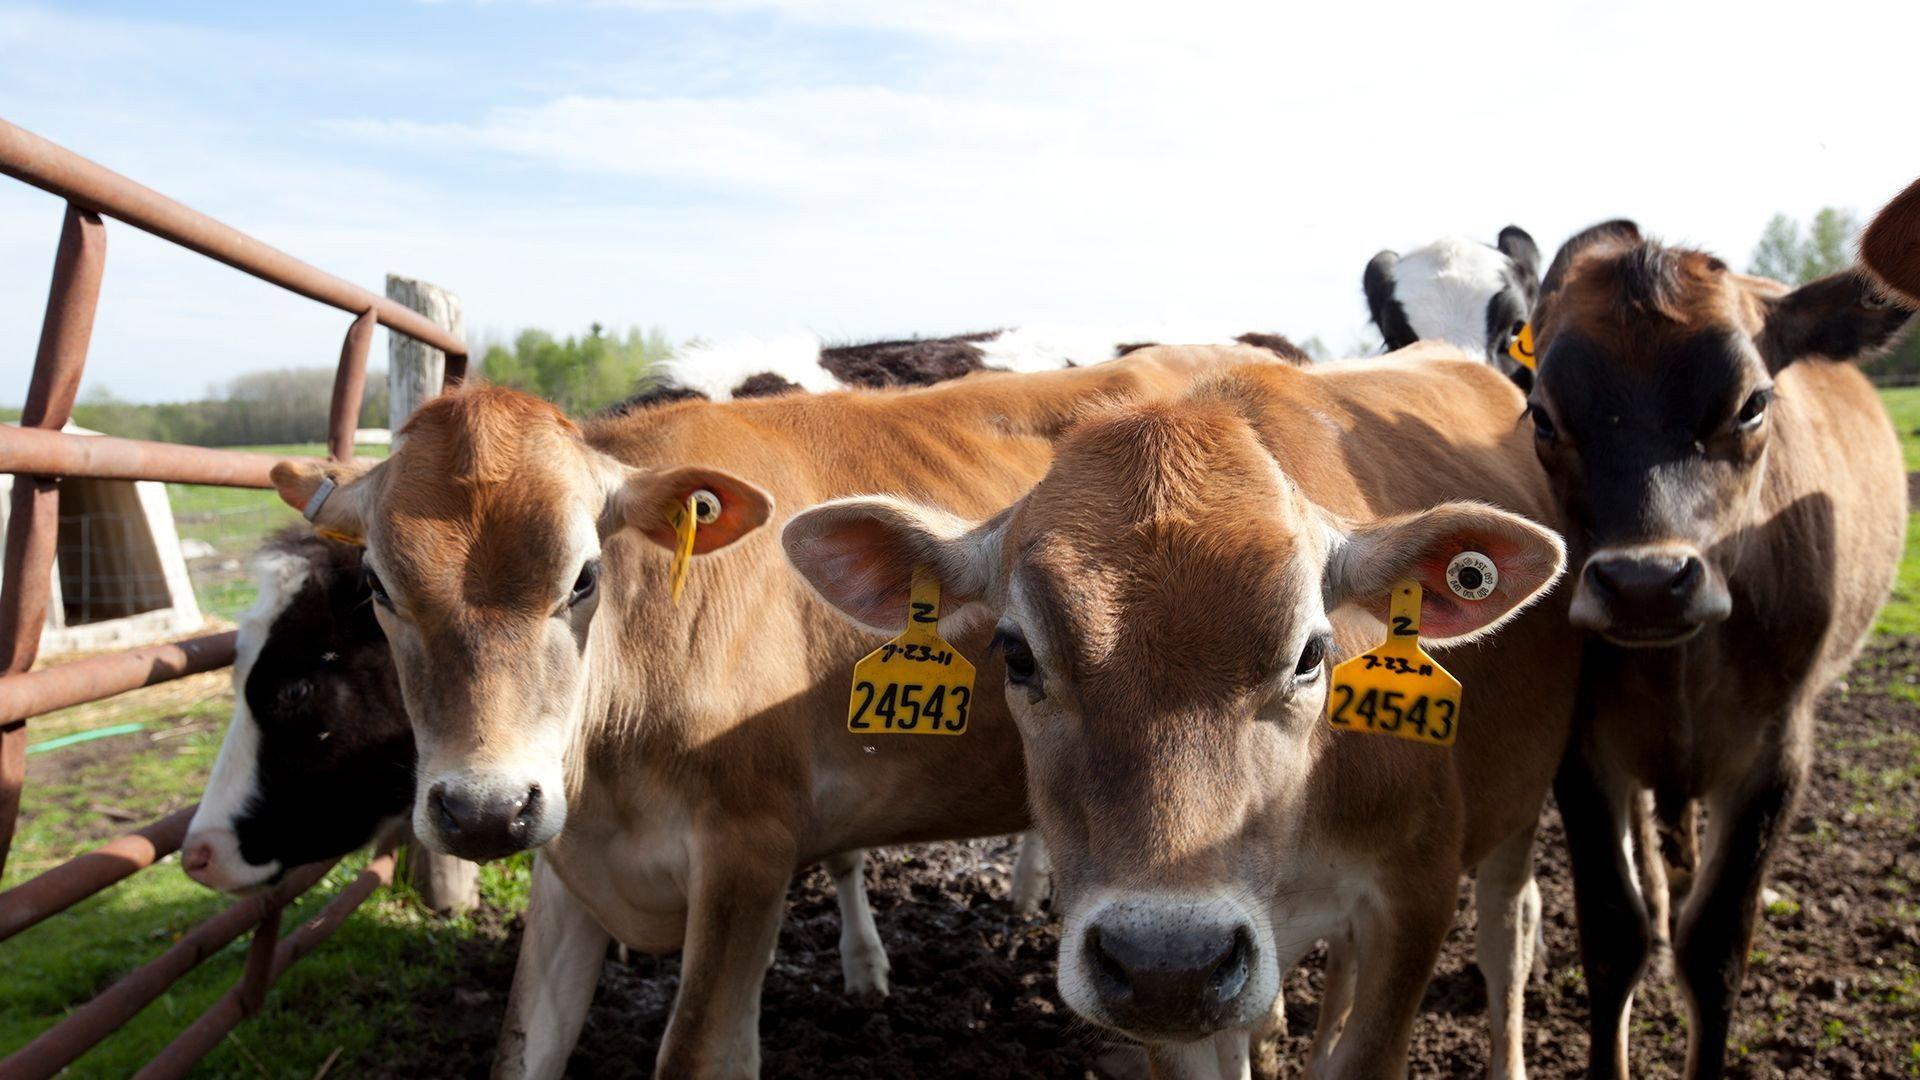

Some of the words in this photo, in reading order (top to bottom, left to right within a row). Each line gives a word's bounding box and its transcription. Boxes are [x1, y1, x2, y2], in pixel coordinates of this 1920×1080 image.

[1392, 616, 1418, 636] 2
[850, 681, 970, 731] 24543
[1331, 684, 1455, 739] 24543
